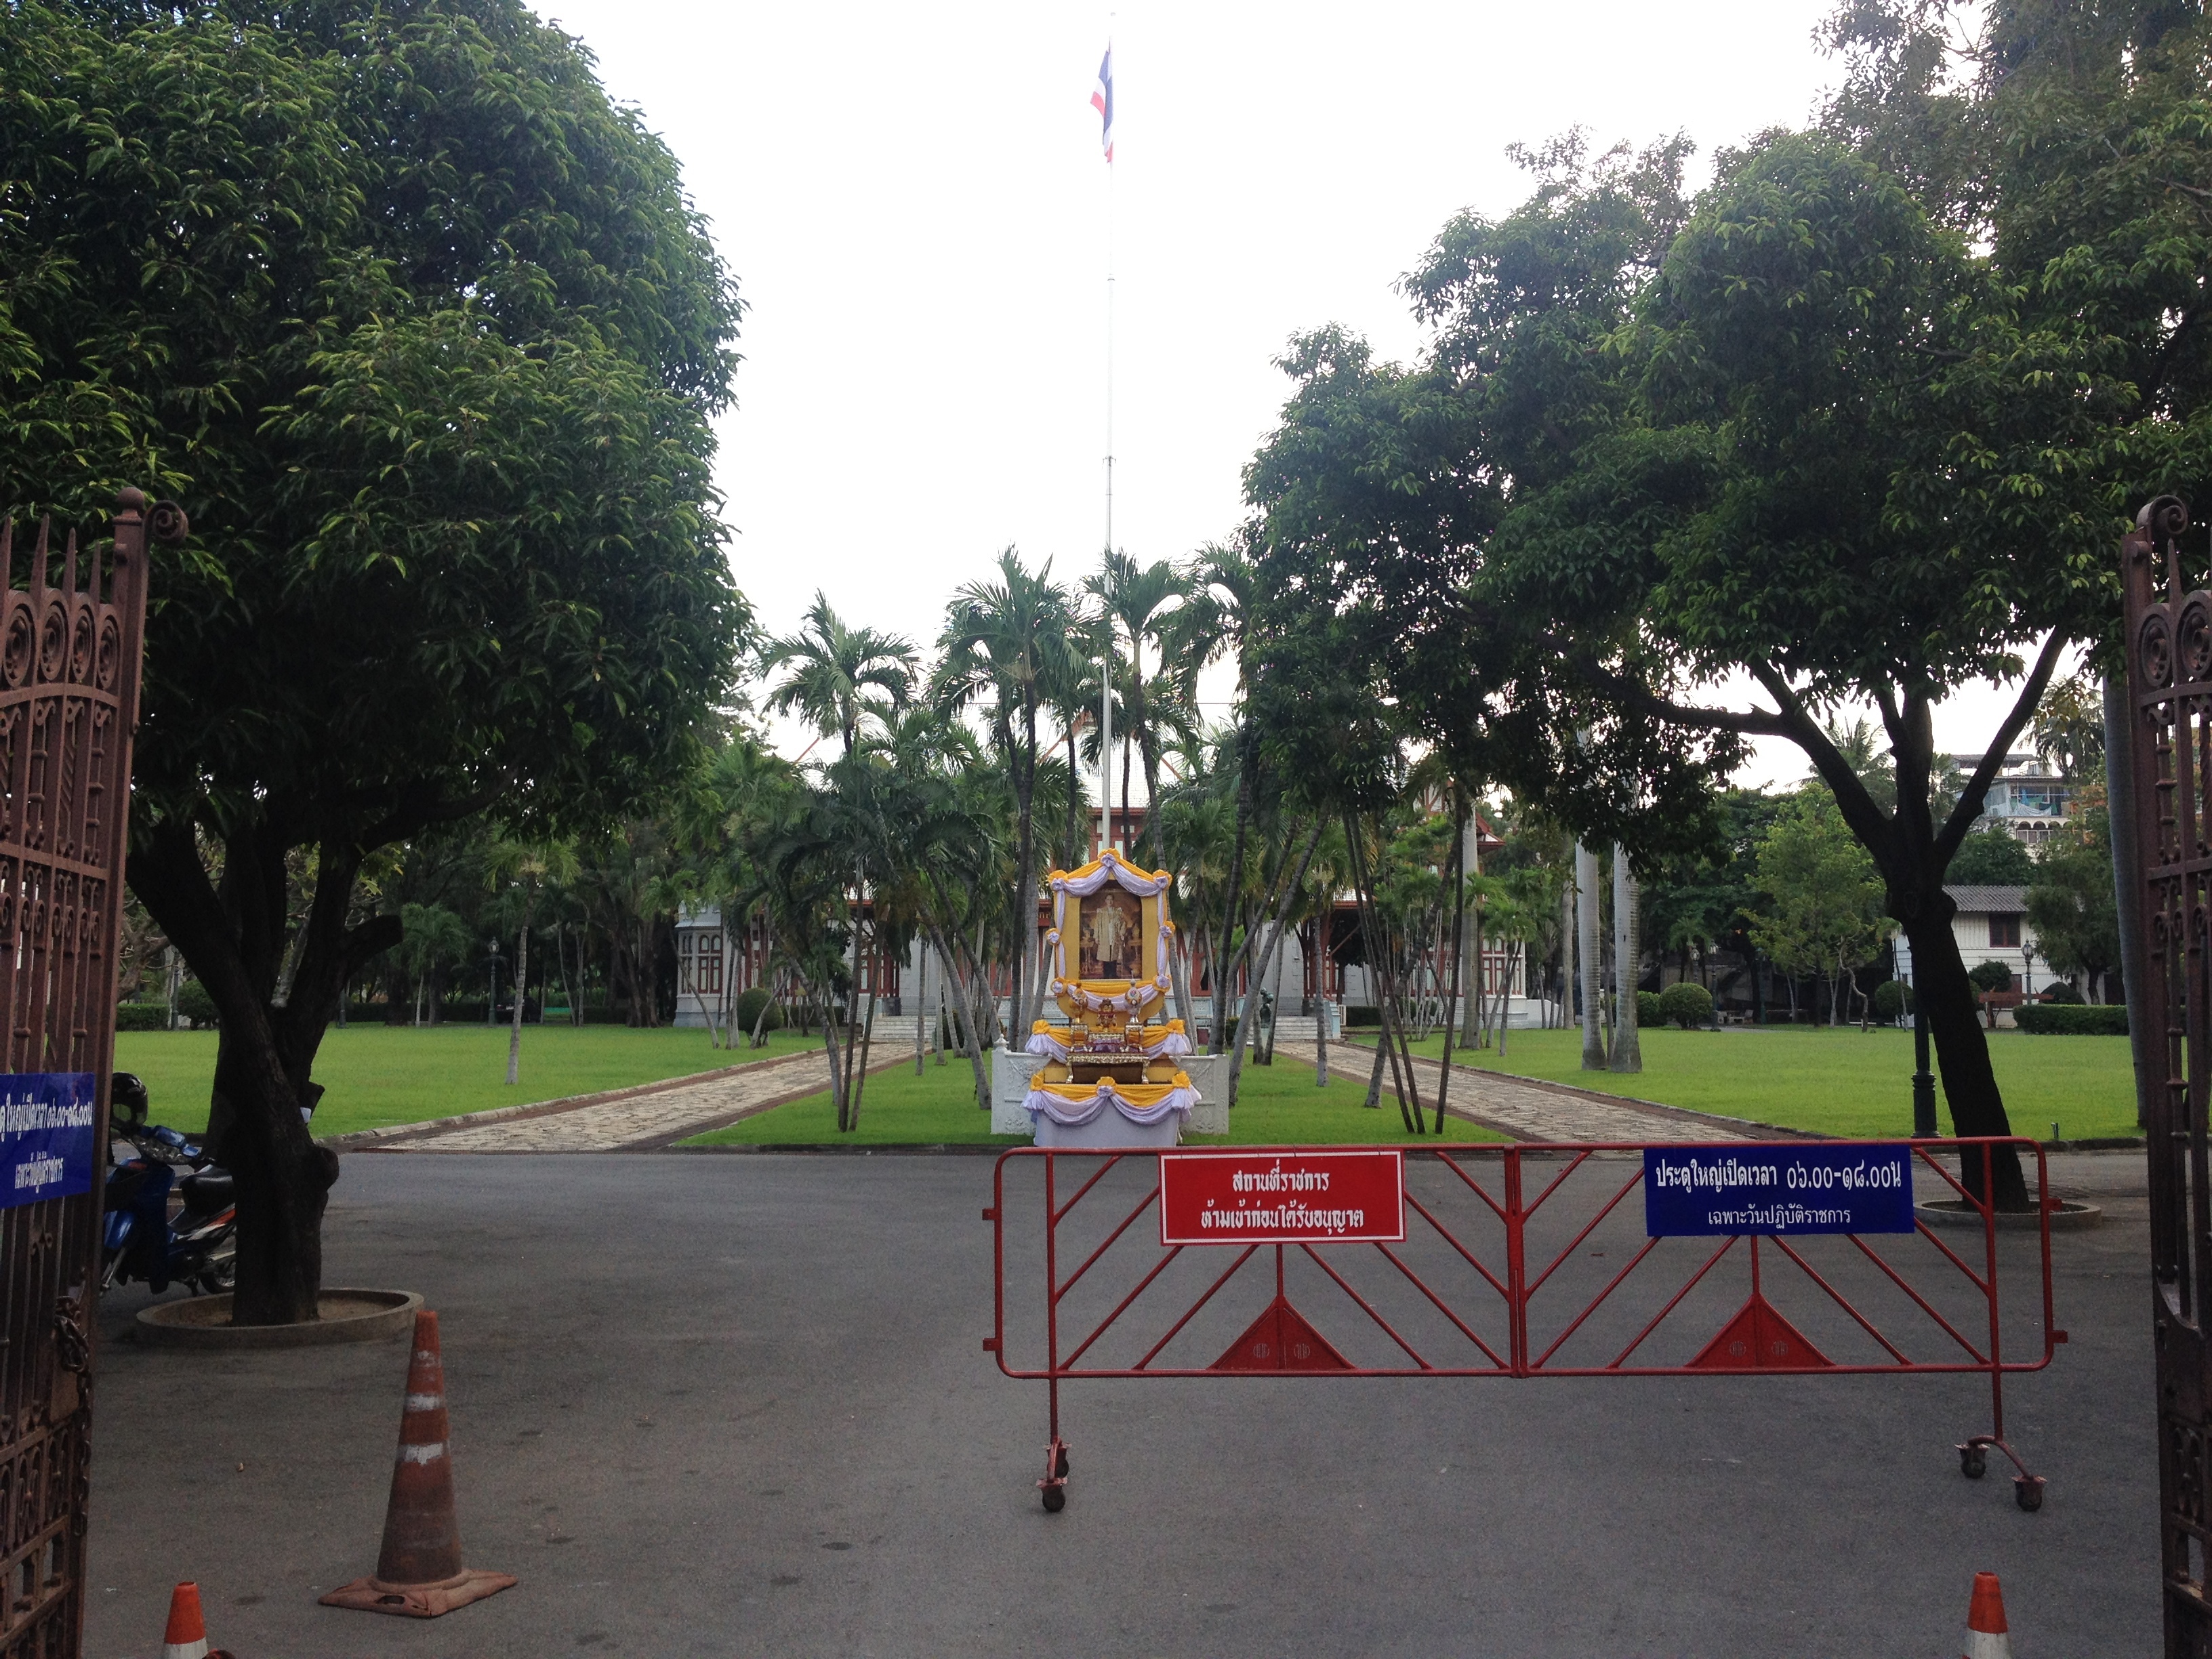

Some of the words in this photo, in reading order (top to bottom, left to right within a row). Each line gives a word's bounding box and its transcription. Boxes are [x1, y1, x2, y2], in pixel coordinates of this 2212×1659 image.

[1233, 1158, 1330, 1191] สถานที่ราชการ
[1656, 1158, 1777, 1193] ประตูใหญ่เปิดเวลา
[1201, 1198, 1364, 1235] ห้ามเข้าก่อนได้รับอนุญาต
[1708, 1203, 1851, 1229] เฉพาะวันปฏิบัติราชการ
